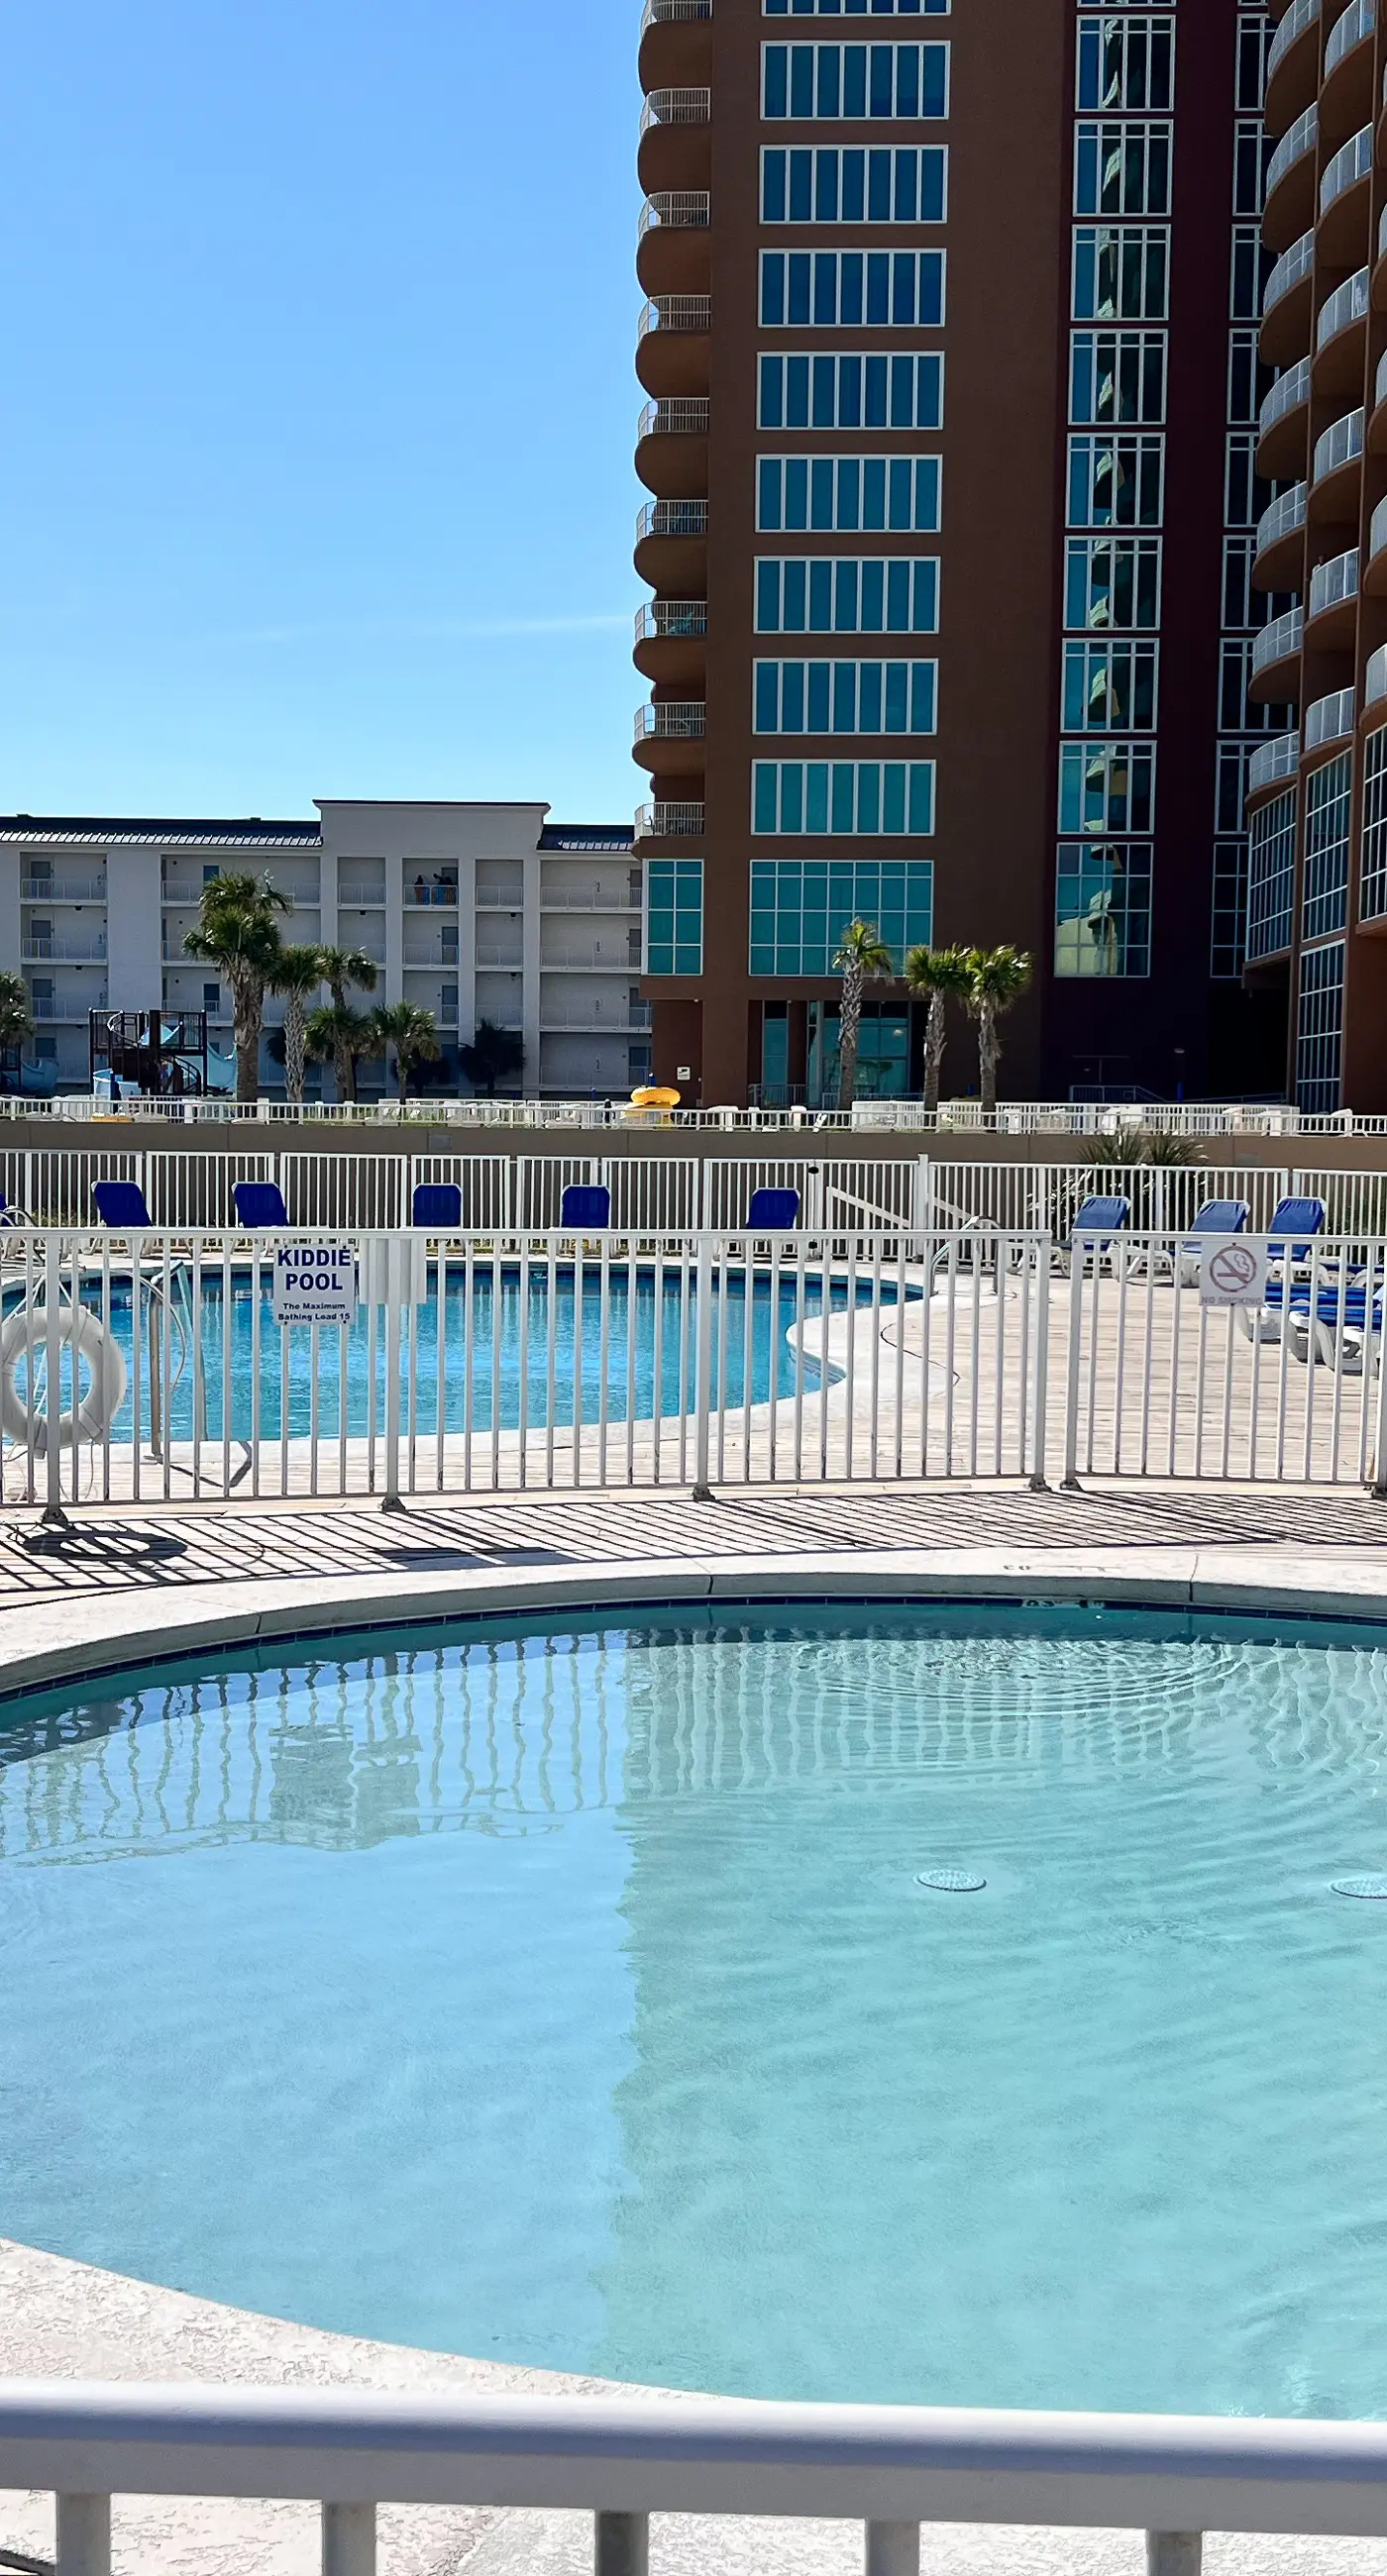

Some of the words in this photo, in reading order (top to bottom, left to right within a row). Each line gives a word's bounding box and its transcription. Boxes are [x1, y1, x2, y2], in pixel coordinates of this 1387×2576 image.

[277, 1249, 351, 1267] KIDDIE
[285, 1273, 343, 1290] POOL
[277, 1313, 312, 1322] Bathing
